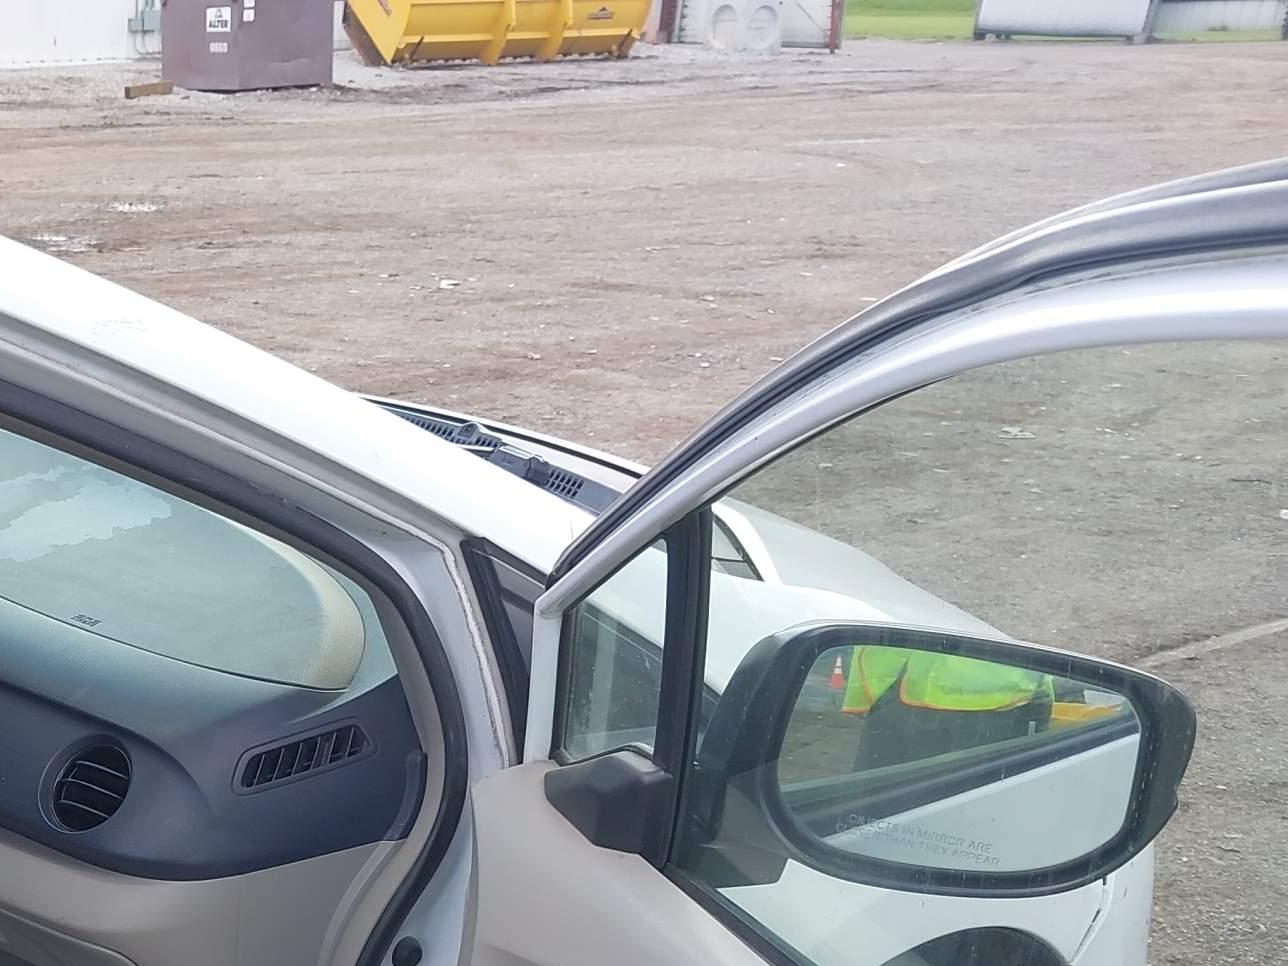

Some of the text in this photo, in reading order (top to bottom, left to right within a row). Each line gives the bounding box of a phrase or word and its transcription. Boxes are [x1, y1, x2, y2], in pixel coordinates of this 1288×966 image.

[902, 825, 915, 837] IN
[916, 828, 965, 847] MIRROR
[968, 840, 993, 855] ARE
[951, 848, 1000, 865] APPEAR
